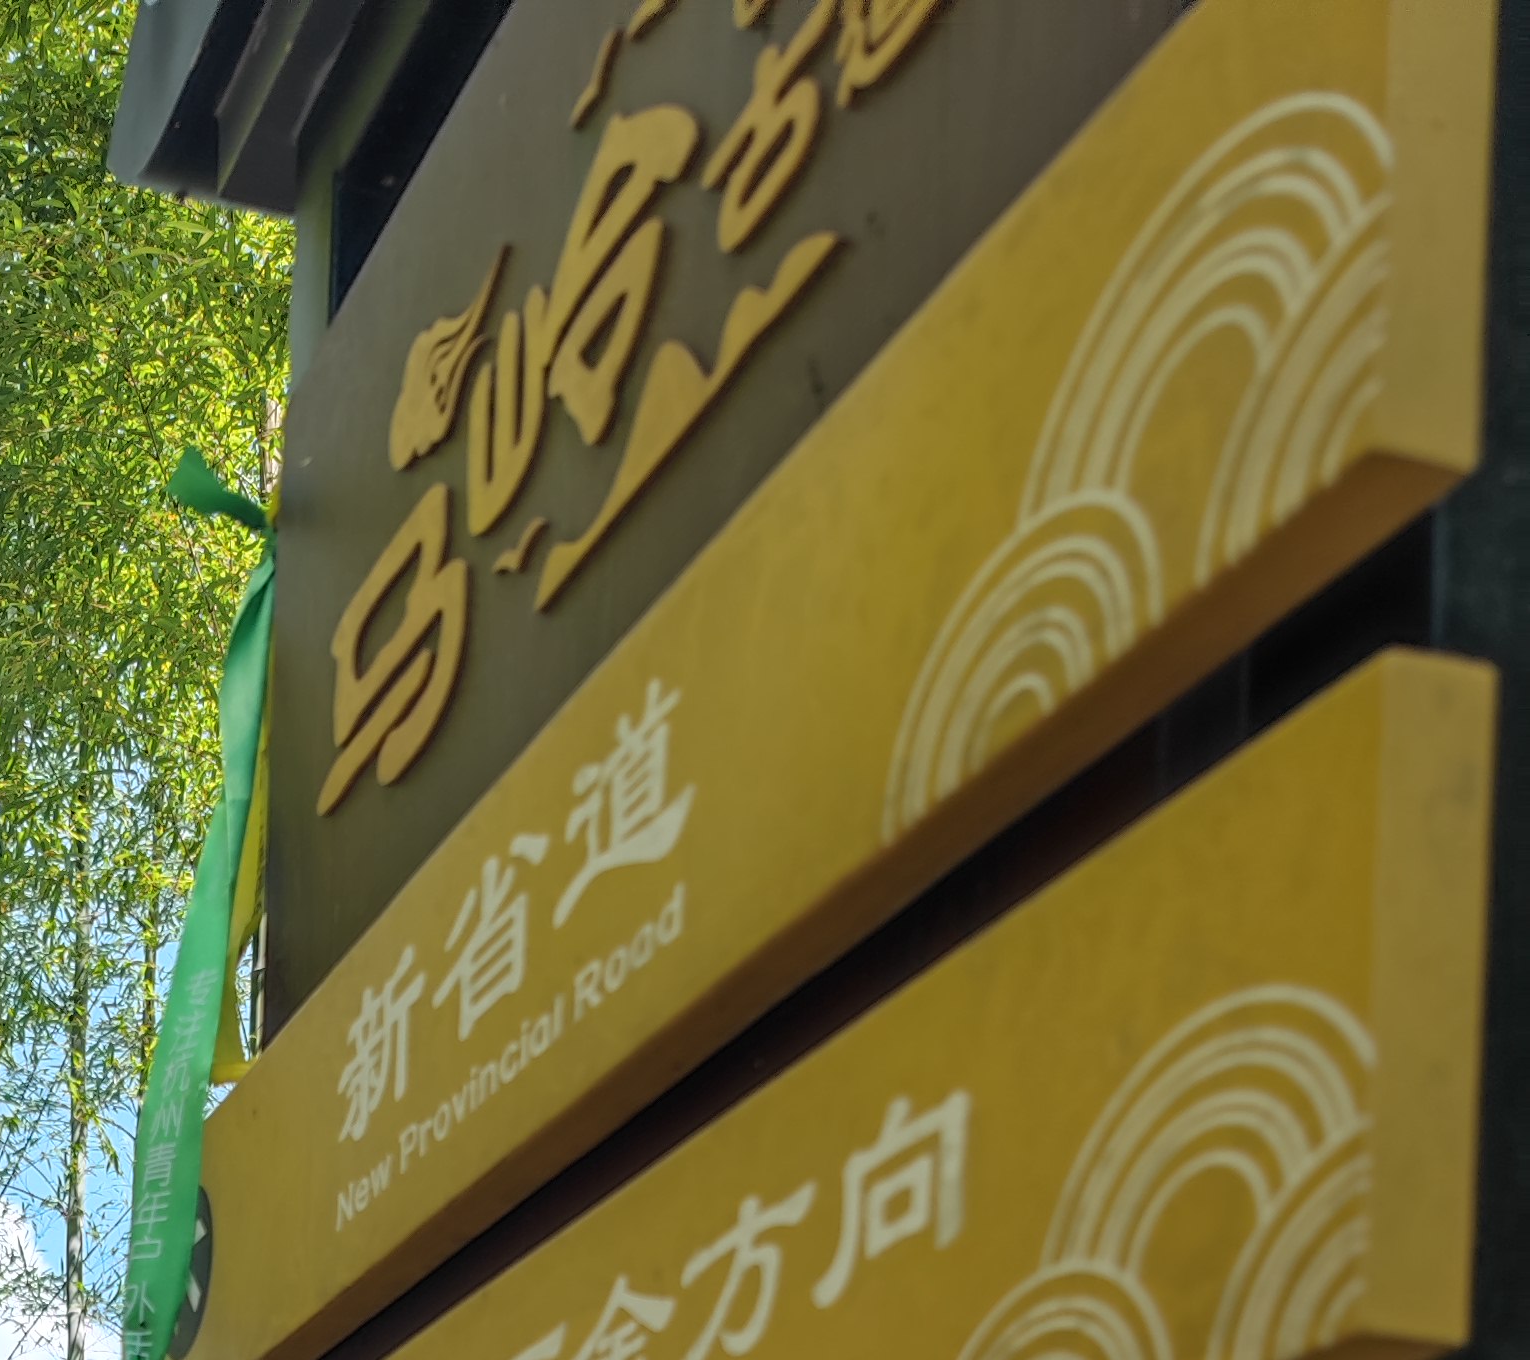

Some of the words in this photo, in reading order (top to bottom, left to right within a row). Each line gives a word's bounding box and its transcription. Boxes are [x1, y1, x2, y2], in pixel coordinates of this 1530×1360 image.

[334, 1155, 392, 1231] New
[398, 996, 566, 1176] Provincial
[572, 885, 685, 1019] Road
[338, 676, 696, 1142] 新省道
